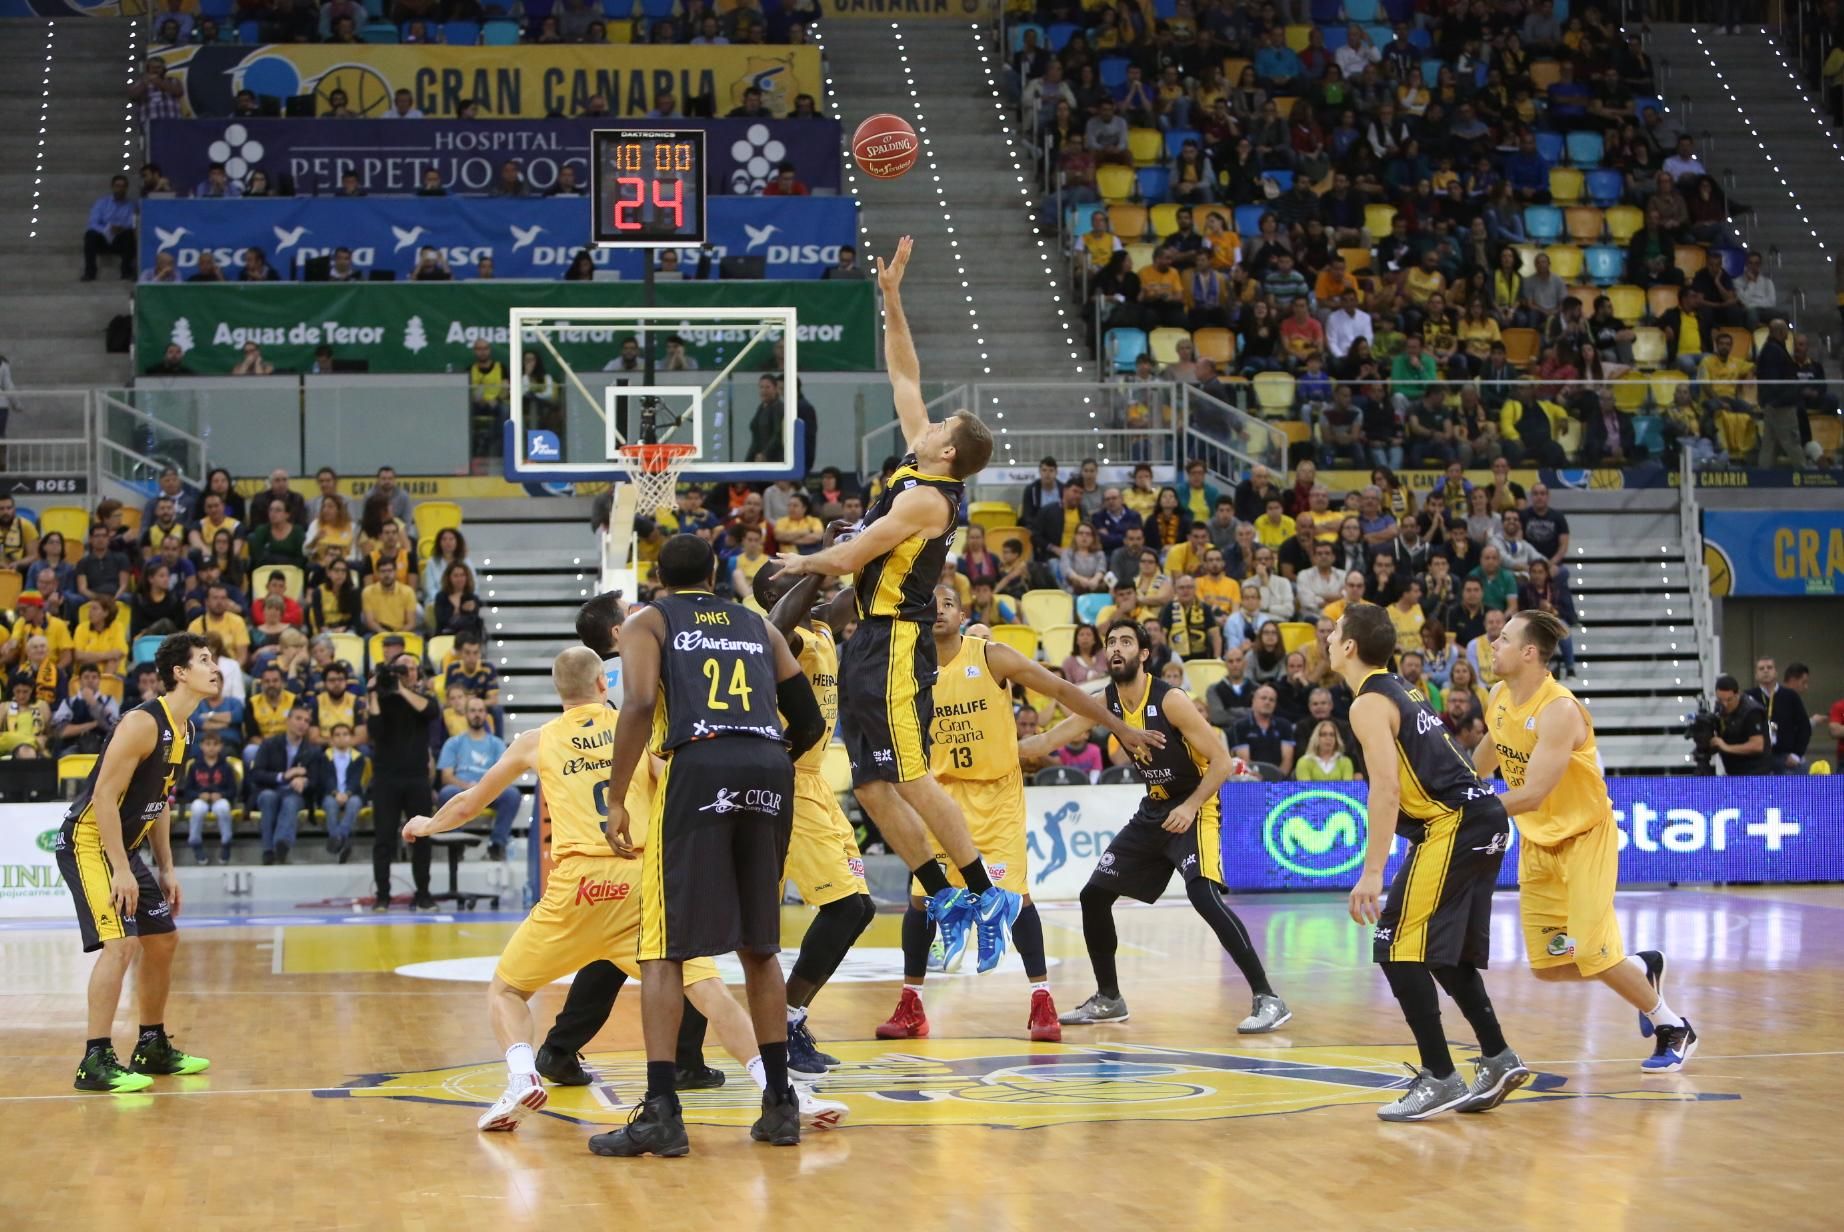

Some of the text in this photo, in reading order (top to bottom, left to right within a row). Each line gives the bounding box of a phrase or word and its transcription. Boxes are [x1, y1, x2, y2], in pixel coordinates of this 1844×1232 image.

[415, 67, 718, 115] GRAN CANARIA
[434, 131, 563, 151] HOSPITAL
[866, 138, 912, 158] SPALDING
[616, 143, 691, 171] 10 00
[614, 177, 684, 230] 24
[212, 321, 385, 349] Aguas de Teror
[35, 479, 77, 492] ROES
[694, 611, 731, 626] JONES
[702, 657, 754, 712] 24
[571, 728, 614, 750] SALIN
[949, 746, 974, 769] 13
[575, 876, 631, 906] Kalise
